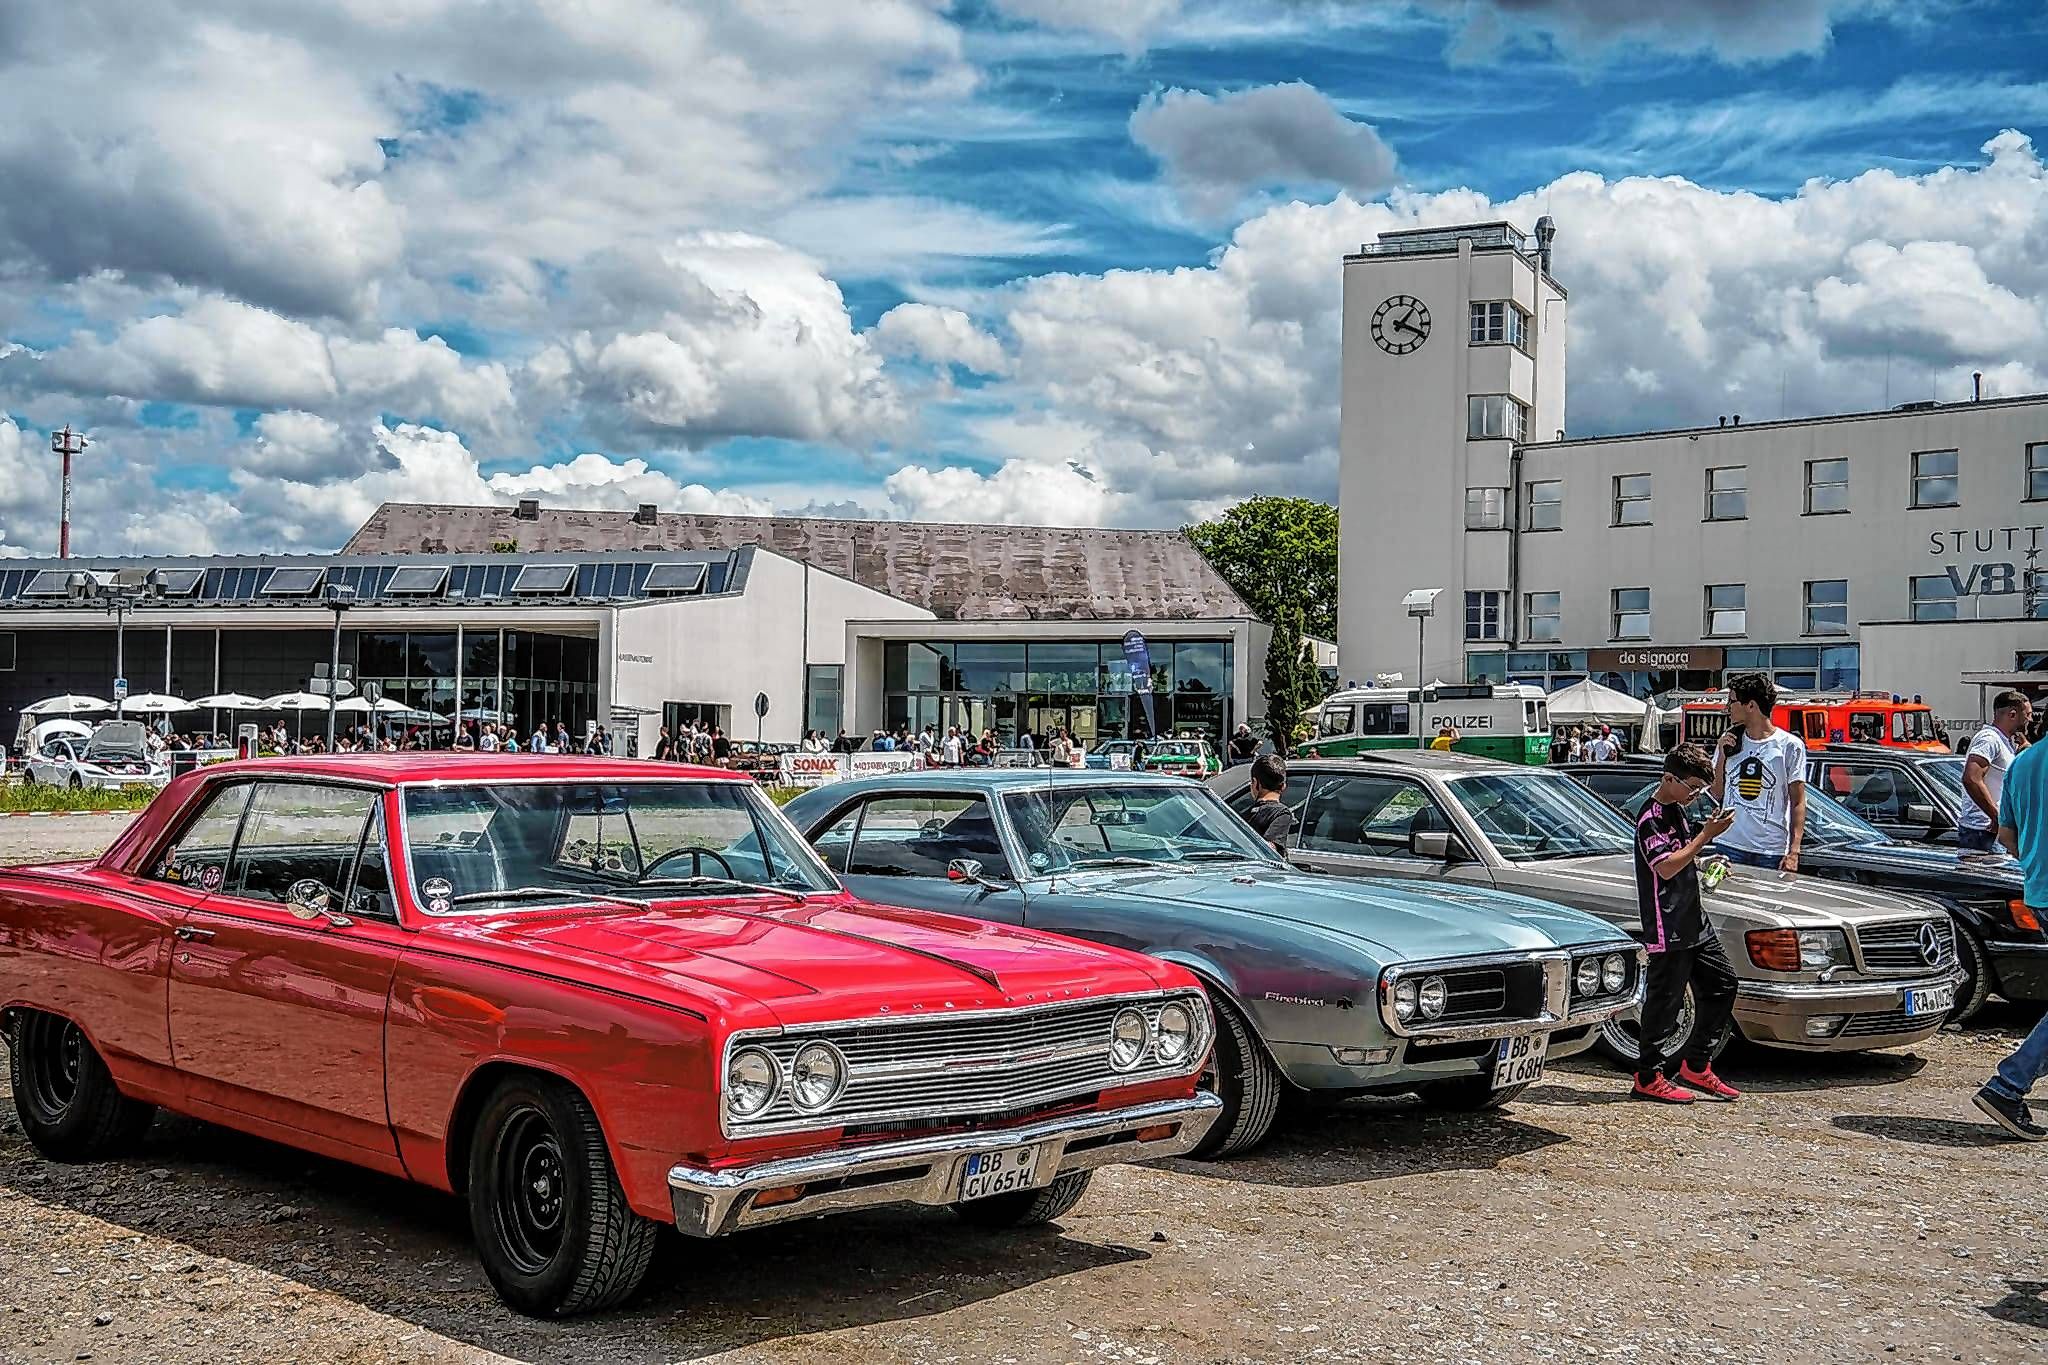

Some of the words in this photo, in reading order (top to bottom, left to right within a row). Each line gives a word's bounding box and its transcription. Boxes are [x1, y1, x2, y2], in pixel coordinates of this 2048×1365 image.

[1930, 526, 2045, 555] STUTT
[1945, 563, 2015, 596] V8
[1619, 651, 1636, 664] da
[1639, 651, 1689, 667] signora
[1431, 715, 1493, 729] POLIZEI
[792, 758, 837, 771] SONAX
[1264, 991, 1325, 1007] Firebird
[1913, 991, 1929, 1012] RA
[1511, 1036, 1530, 1059] BB
[979, 1152, 1003, 1174] BB
